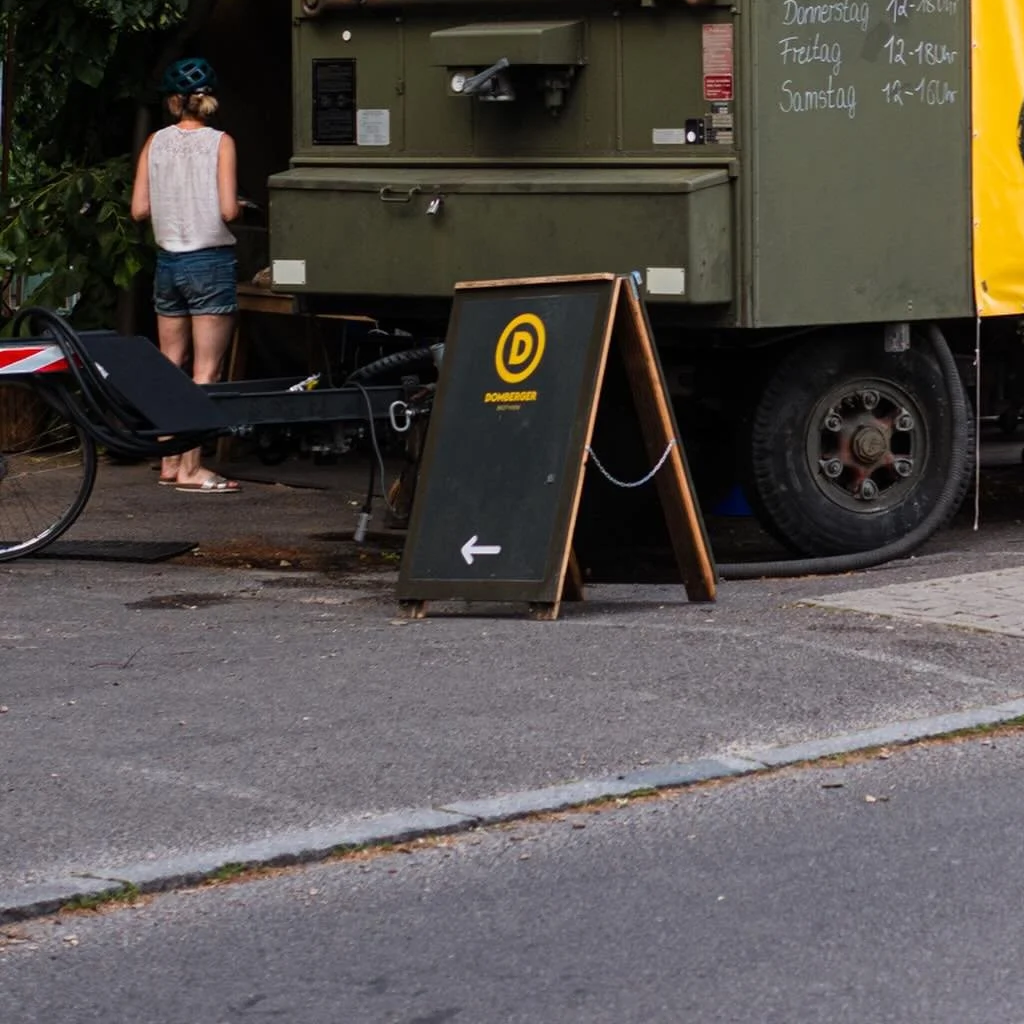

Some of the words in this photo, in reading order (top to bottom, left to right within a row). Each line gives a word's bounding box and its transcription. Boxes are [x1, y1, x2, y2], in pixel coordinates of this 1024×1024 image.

[778, 33, 843, 76] Freitag
[779, 75, 856, 119] Samstag
[484, 391, 537, 403] DOMBERGER
